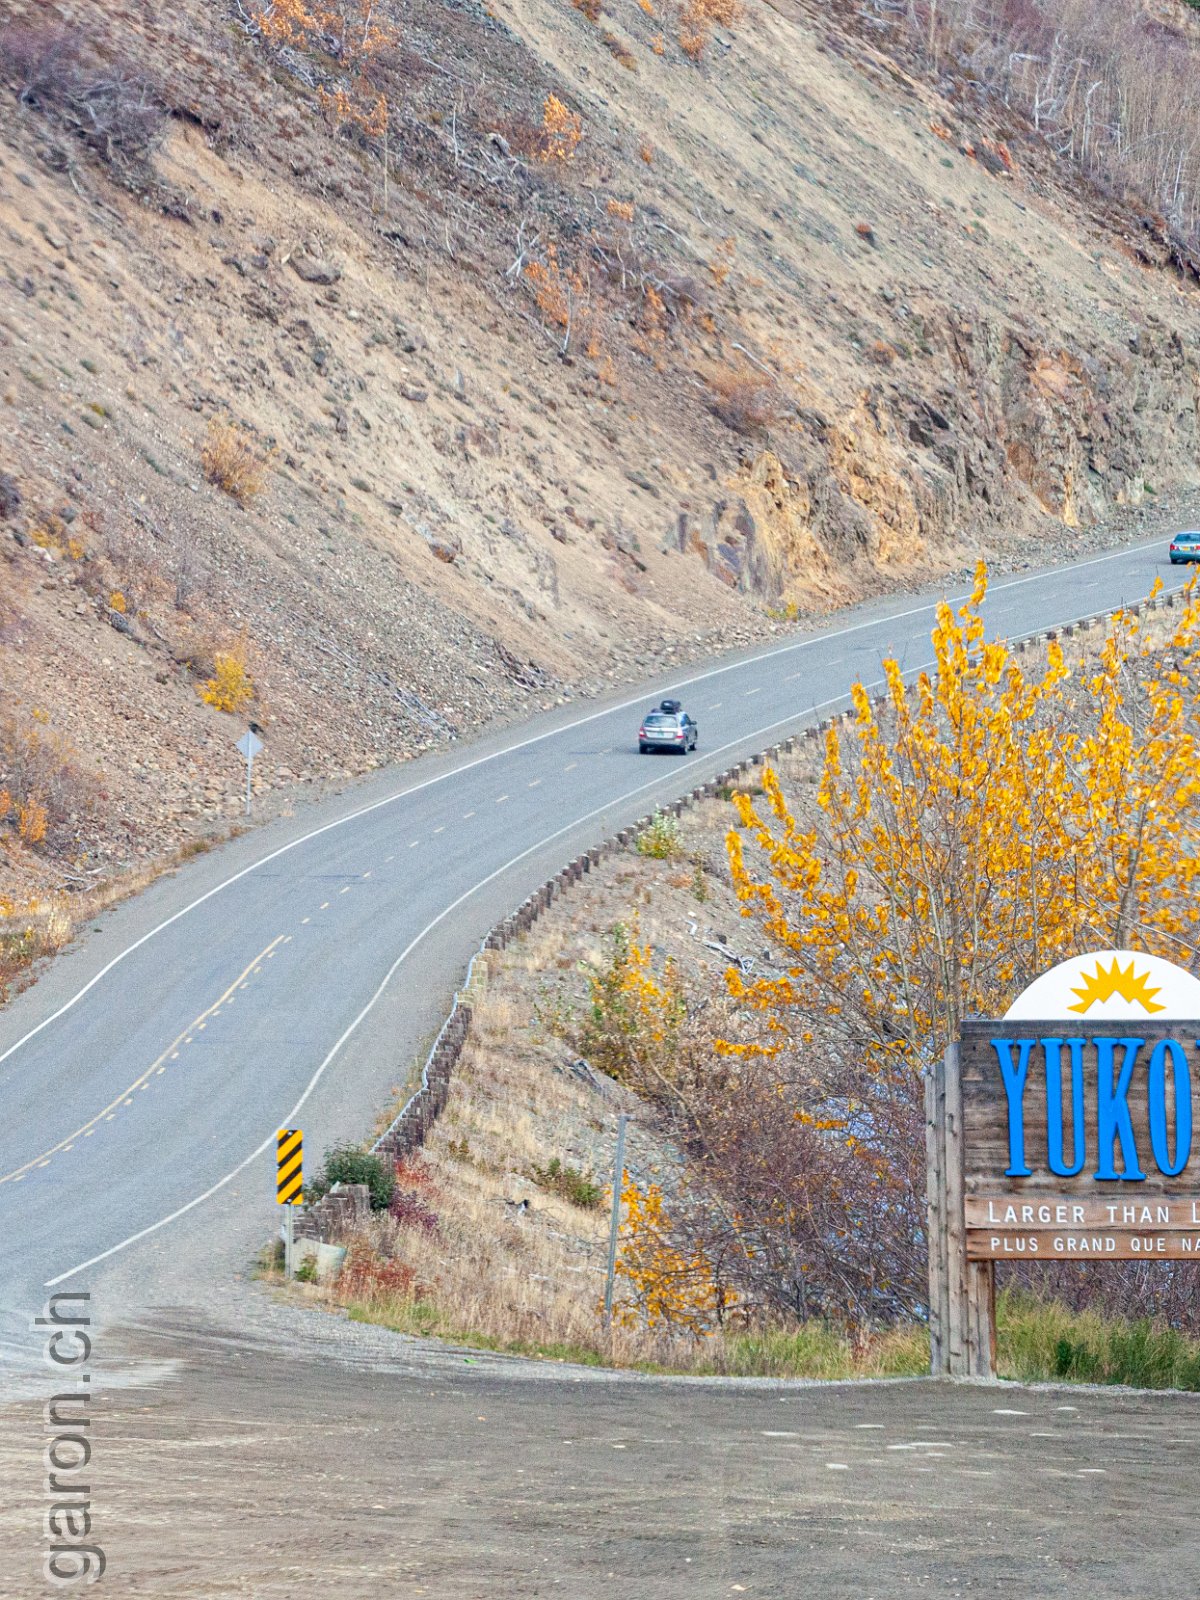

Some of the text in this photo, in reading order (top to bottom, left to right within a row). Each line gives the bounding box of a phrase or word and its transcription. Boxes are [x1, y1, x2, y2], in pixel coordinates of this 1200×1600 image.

[988, 1201, 1085, 1223] LARGER
[1106, 1205, 1169, 1223] THAN
[990, 1237, 1039, 1251] PLUS
[1053, 1237, 1116, 1251] GRAND
[1130, 1237, 1166, 1251] QUE
